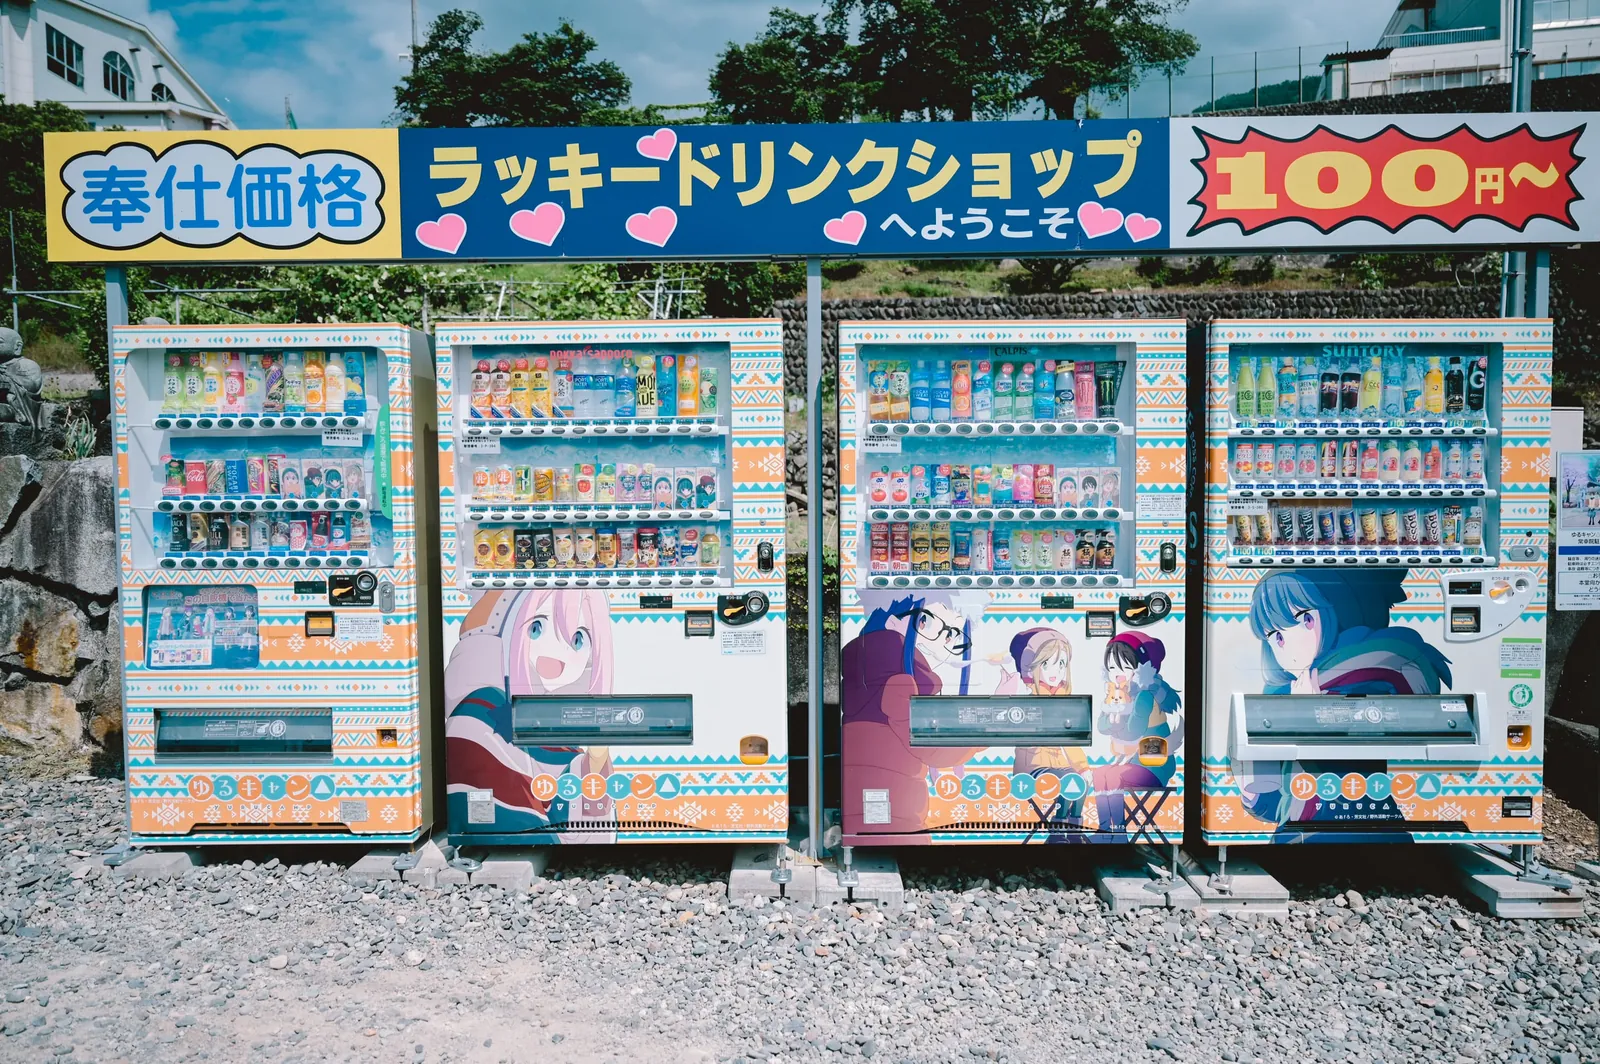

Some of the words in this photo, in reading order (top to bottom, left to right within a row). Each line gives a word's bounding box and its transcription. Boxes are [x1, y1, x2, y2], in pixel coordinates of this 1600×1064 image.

[429, 129, 1143, 208] ラッキードリンクショップ
[82, 162, 367, 232] 奉仕価格
[880, 205, 1075, 241] へようこそ
[994, 346, 1028, 356] CALPIS
[1280, 511, 1294, 542] BLACK
[1301, 511, 1315, 542] BLACK
[1407, 513, 1418, 541] BOSS
[1428, 513, 1438, 541] BOSS
